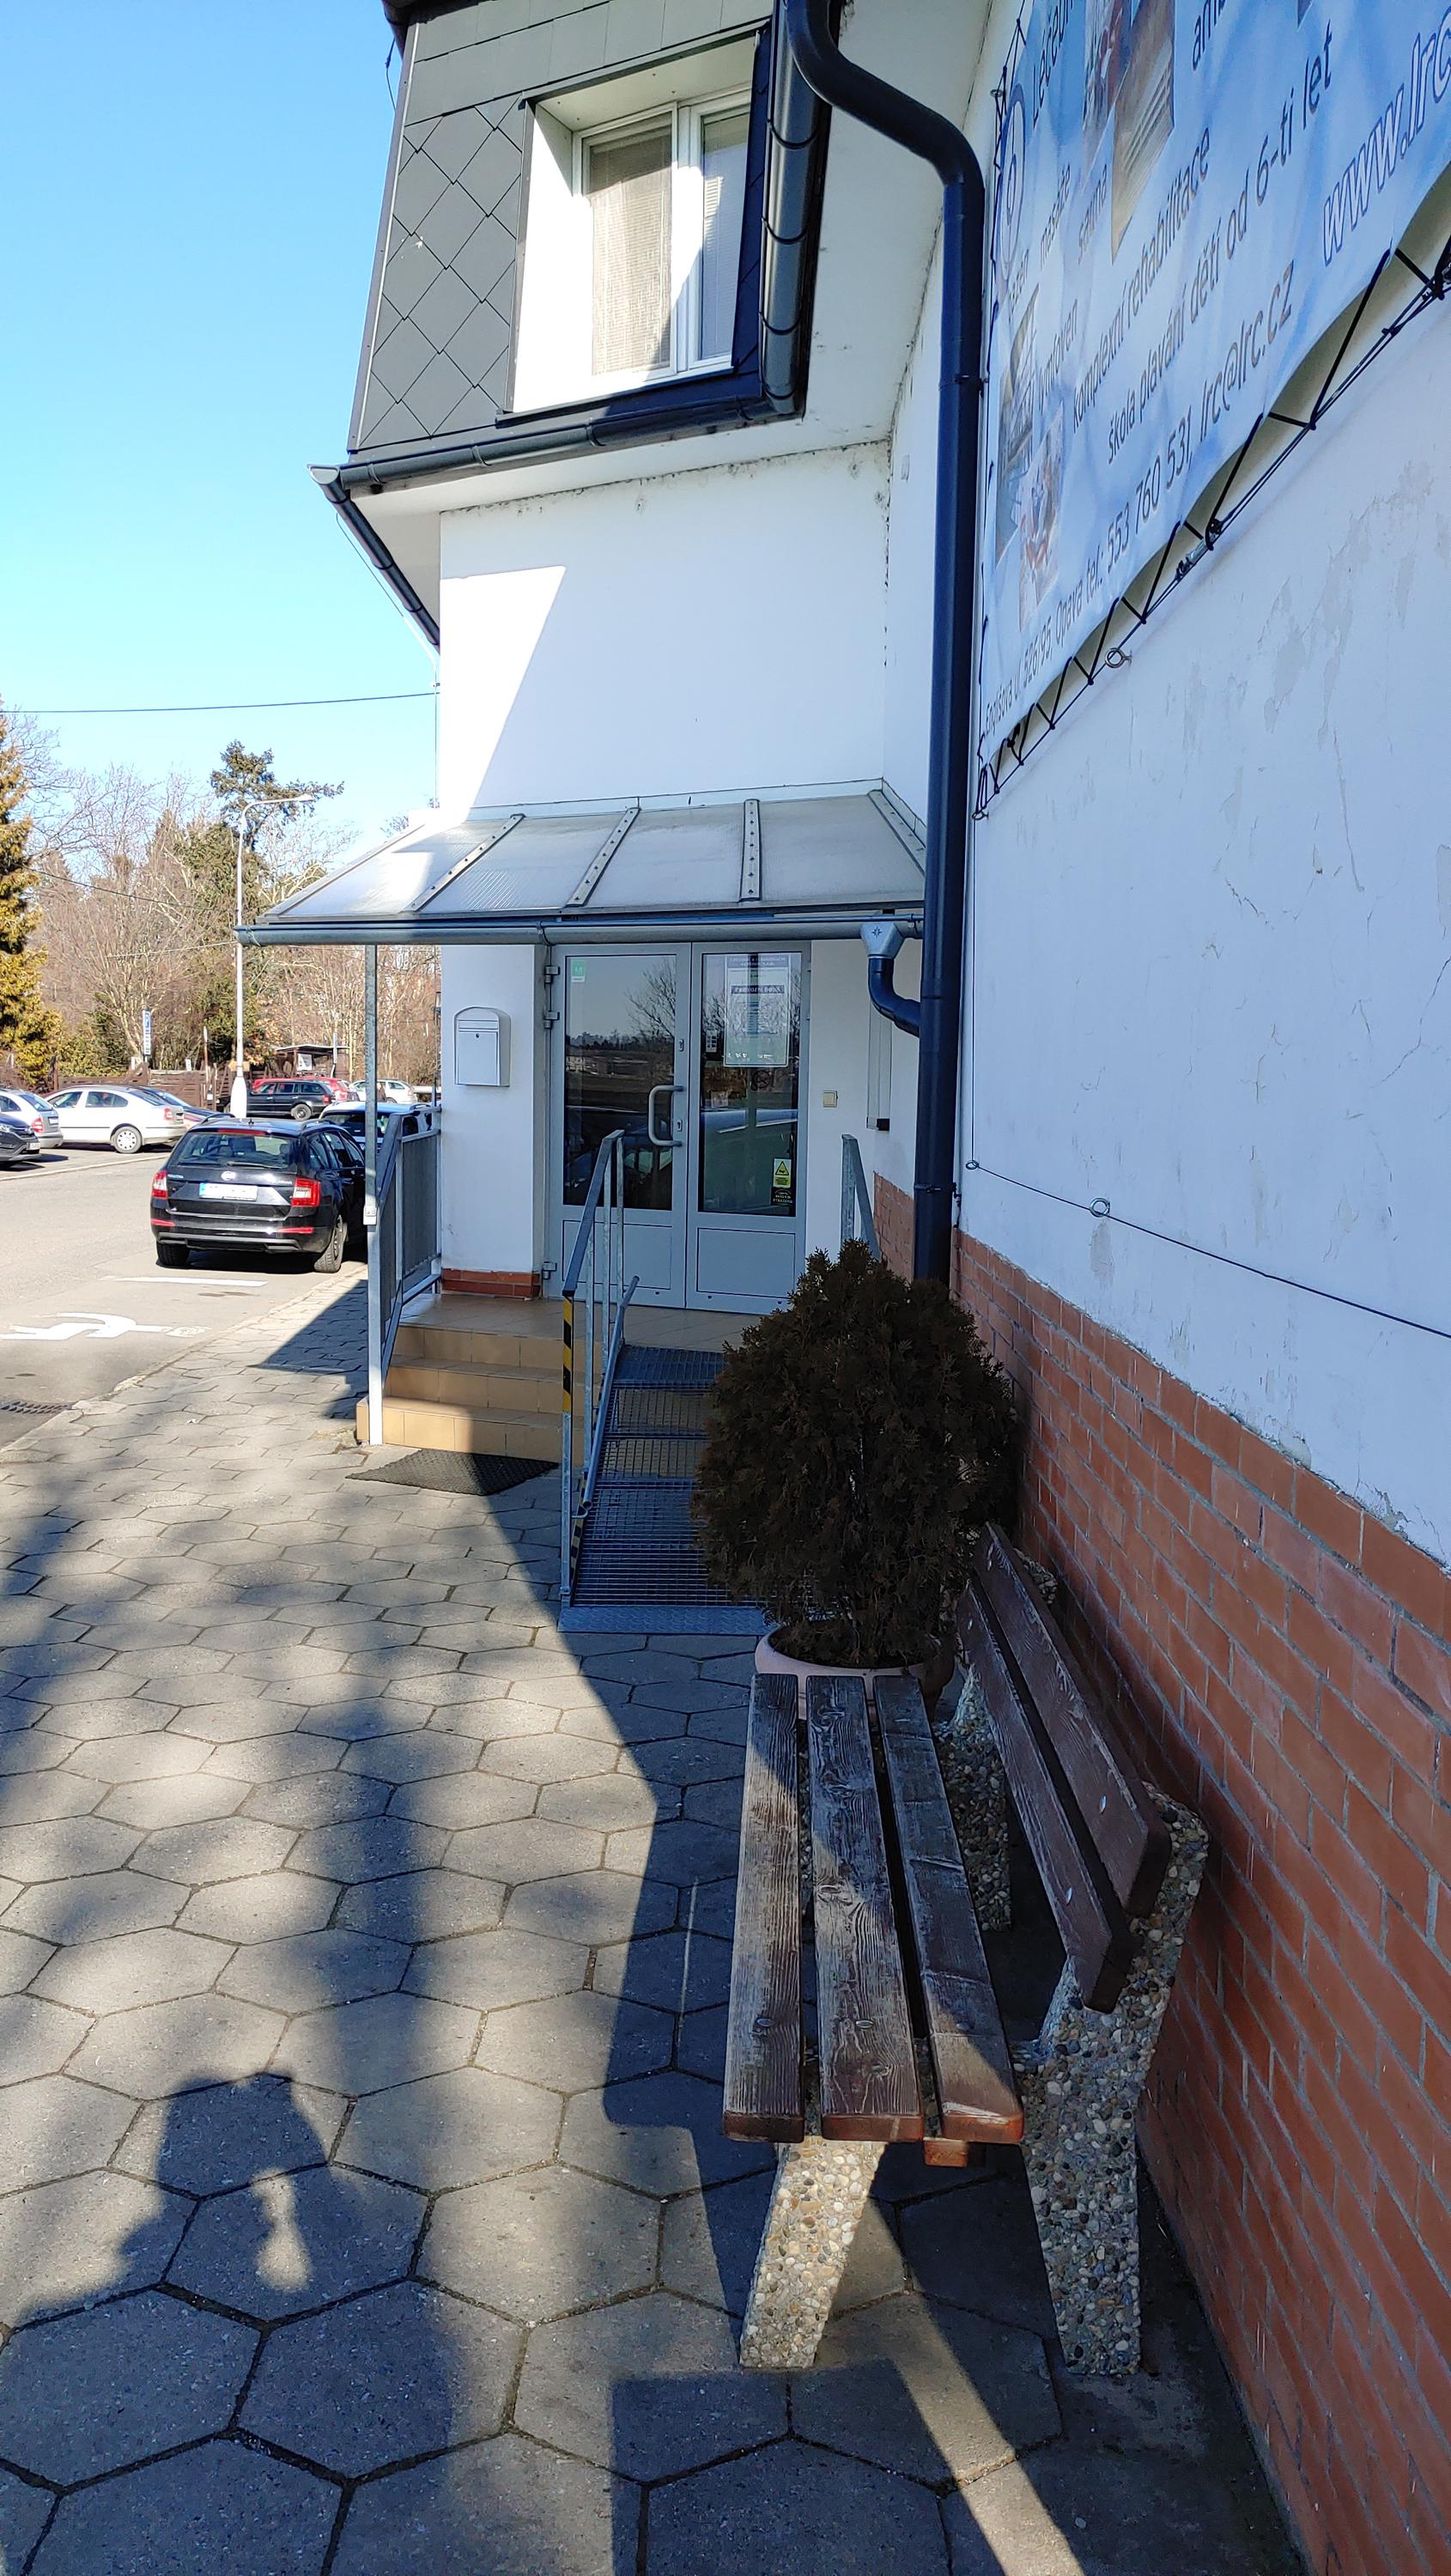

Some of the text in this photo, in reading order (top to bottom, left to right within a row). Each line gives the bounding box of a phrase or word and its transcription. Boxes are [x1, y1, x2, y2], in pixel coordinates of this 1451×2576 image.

[1073, 127, 1210, 431] komplexní rehabilitace
[1108, 20, 1333, 465] škola plavání dětí od 6-ti let
[1055, 580, 1084, 647] Opava
[1108, 501, 1130, 574] 553
[1135, 454, 1161, 535] 760
[1166, 404, 1193, 488] 531,
[1200, 259, 1295, 442] lrc@lrc.cz
